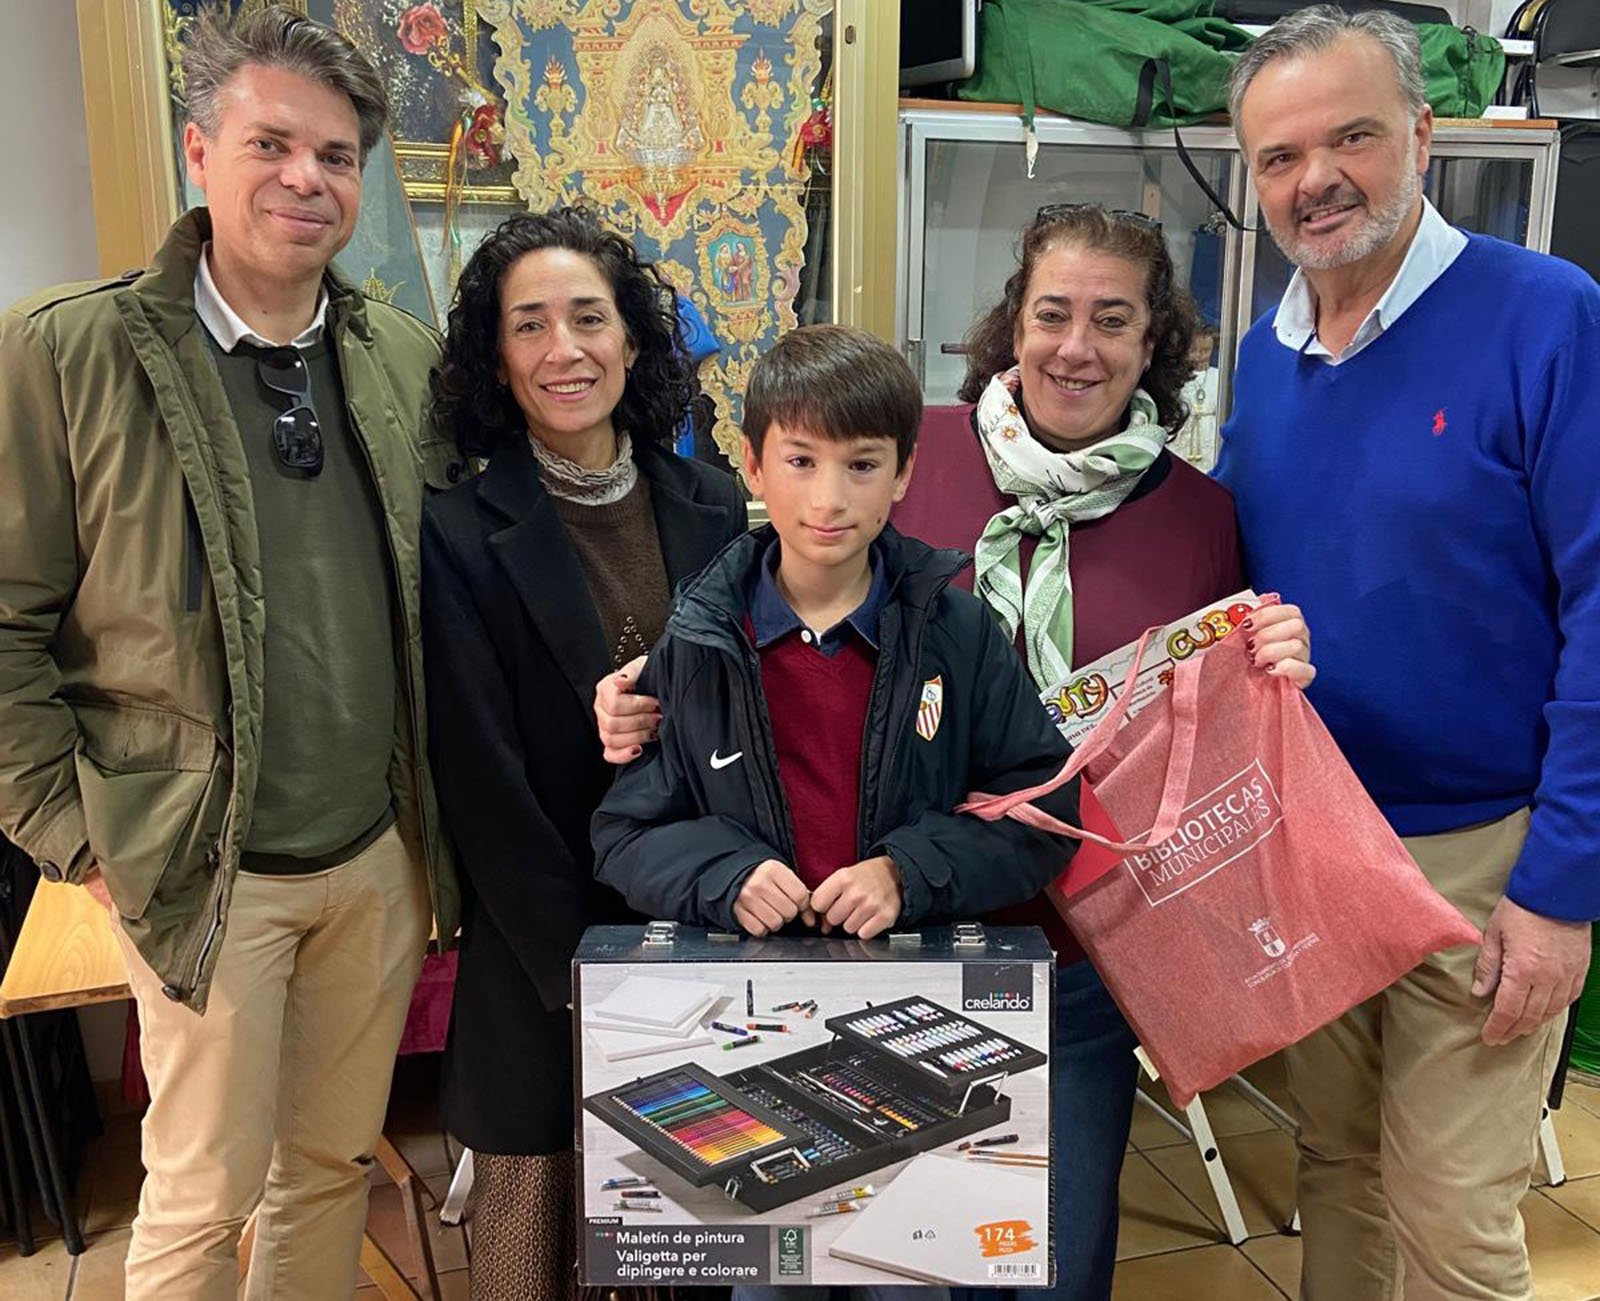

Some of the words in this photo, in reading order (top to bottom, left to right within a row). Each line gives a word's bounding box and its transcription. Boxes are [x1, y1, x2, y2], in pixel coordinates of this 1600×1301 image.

[1133, 777, 1263, 871] BIBLIOTECAS
[1148, 799, 1271, 886] MUNICIPALES
[588, 1217, 620, 1225] PREMIUM
[616, 1231, 669, 1244] Maletín
[673, 1231, 691, 1244] de
[695, 1231, 745, 1247] pintura
[984, 1227, 1015, 1242] 174
[616, 1250, 679, 1266] Valigetta
[682, 1253, 707, 1265] per
[616, 1264, 685, 1280] dipingere
[688, 1265, 698, 1276] e
[700, 1263, 758, 1277] colorare
